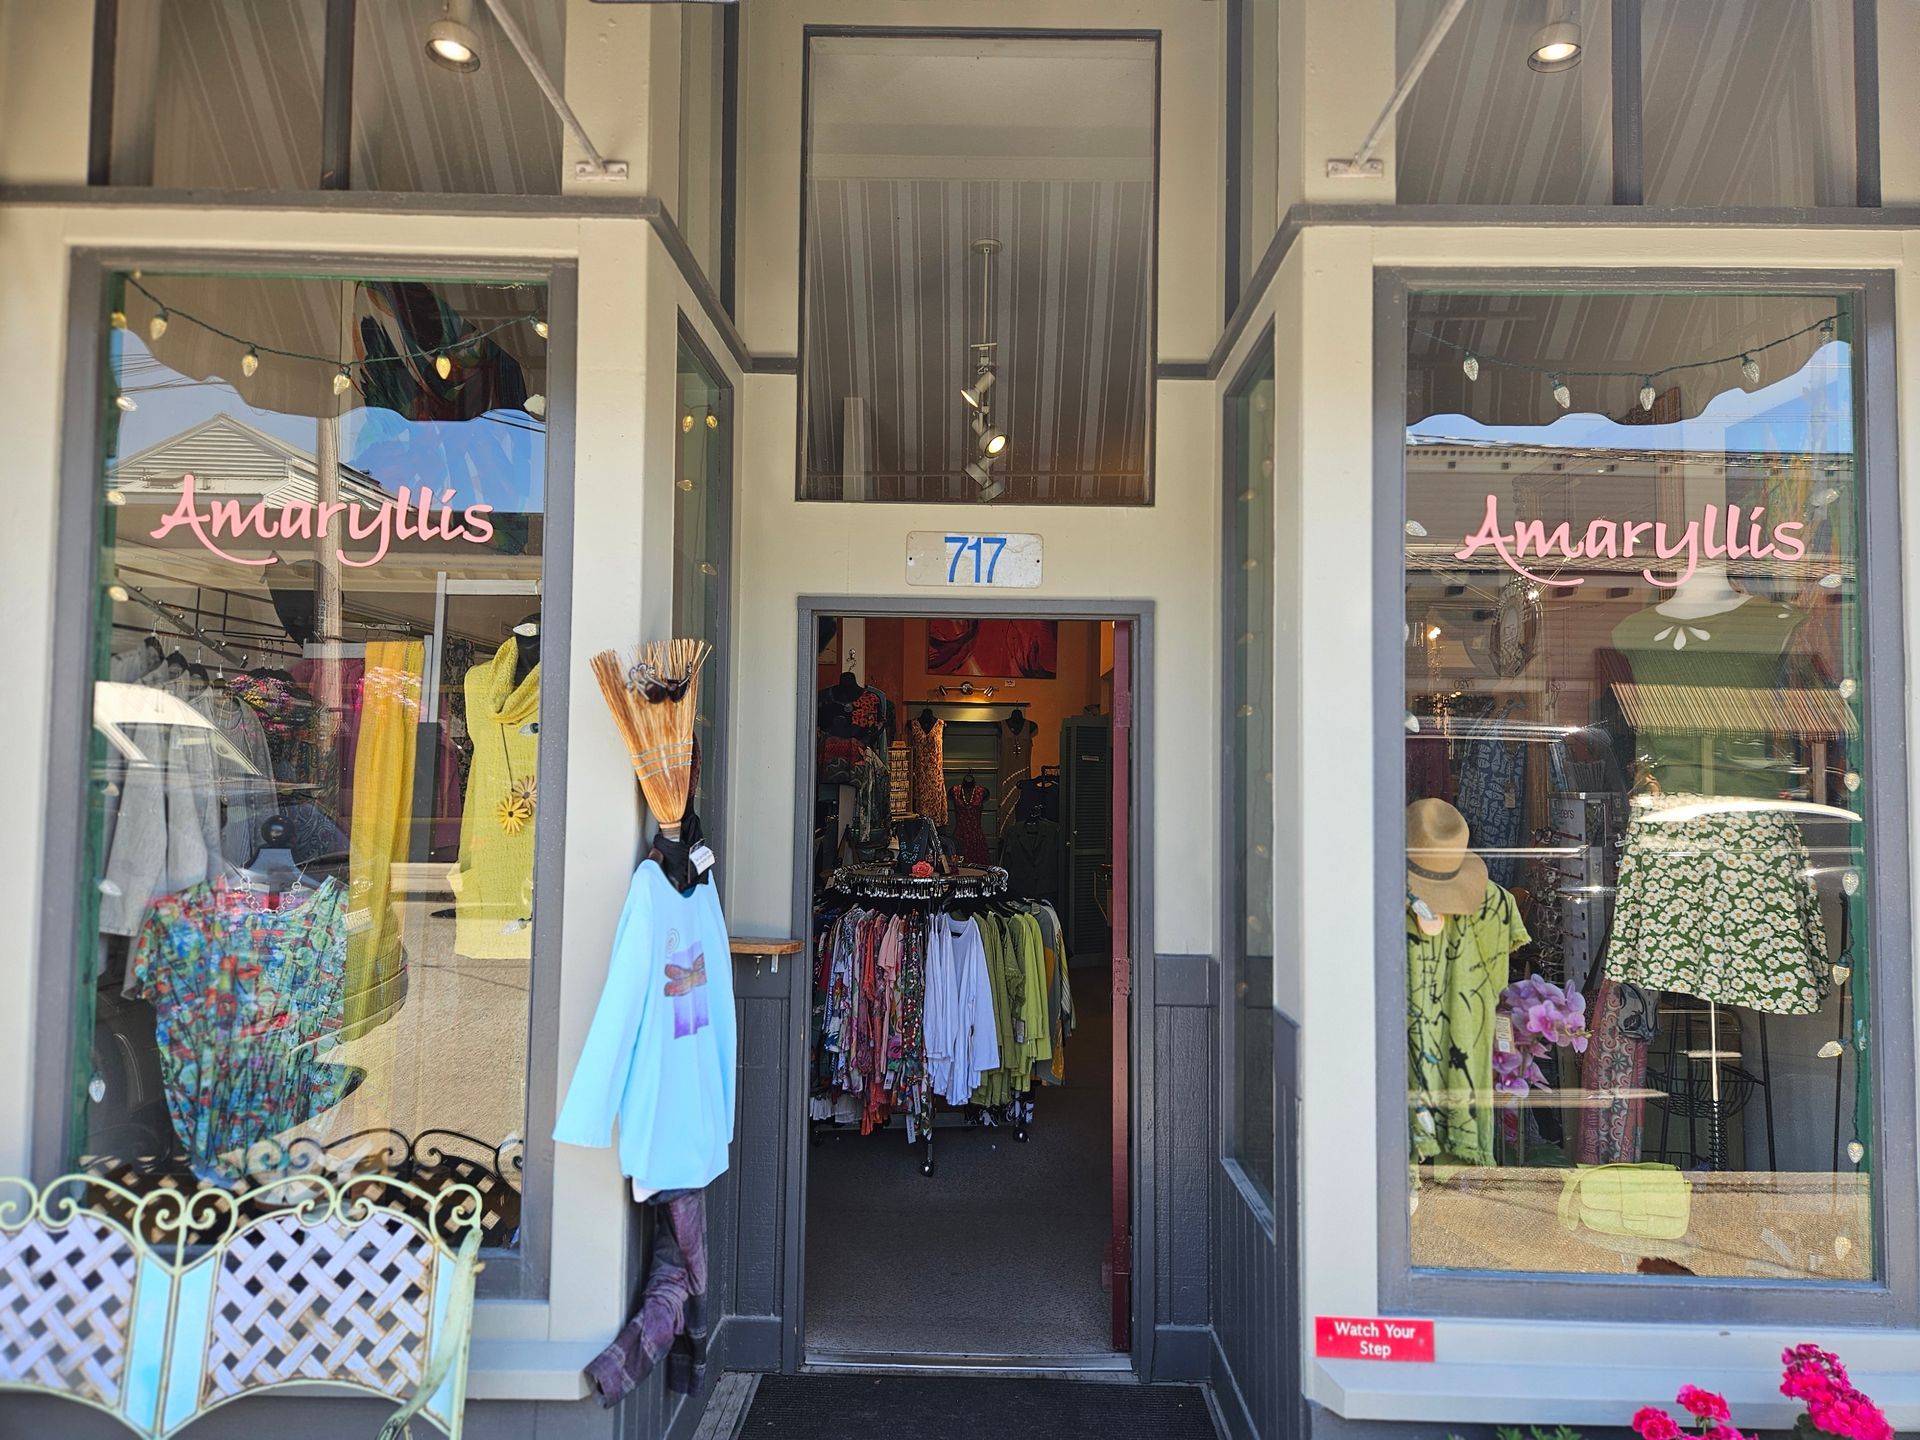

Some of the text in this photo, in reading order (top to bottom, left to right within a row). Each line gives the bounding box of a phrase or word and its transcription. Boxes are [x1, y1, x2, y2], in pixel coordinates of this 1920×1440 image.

[150, 474, 494, 567] Amaryllis
[1454, 495, 1805, 587] Amaryllis
[944, 536, 1007, 583] 717
[1334, 1321, 1415, 1339] Watch Your
[1360, 1340, 1392, 1359] Step
